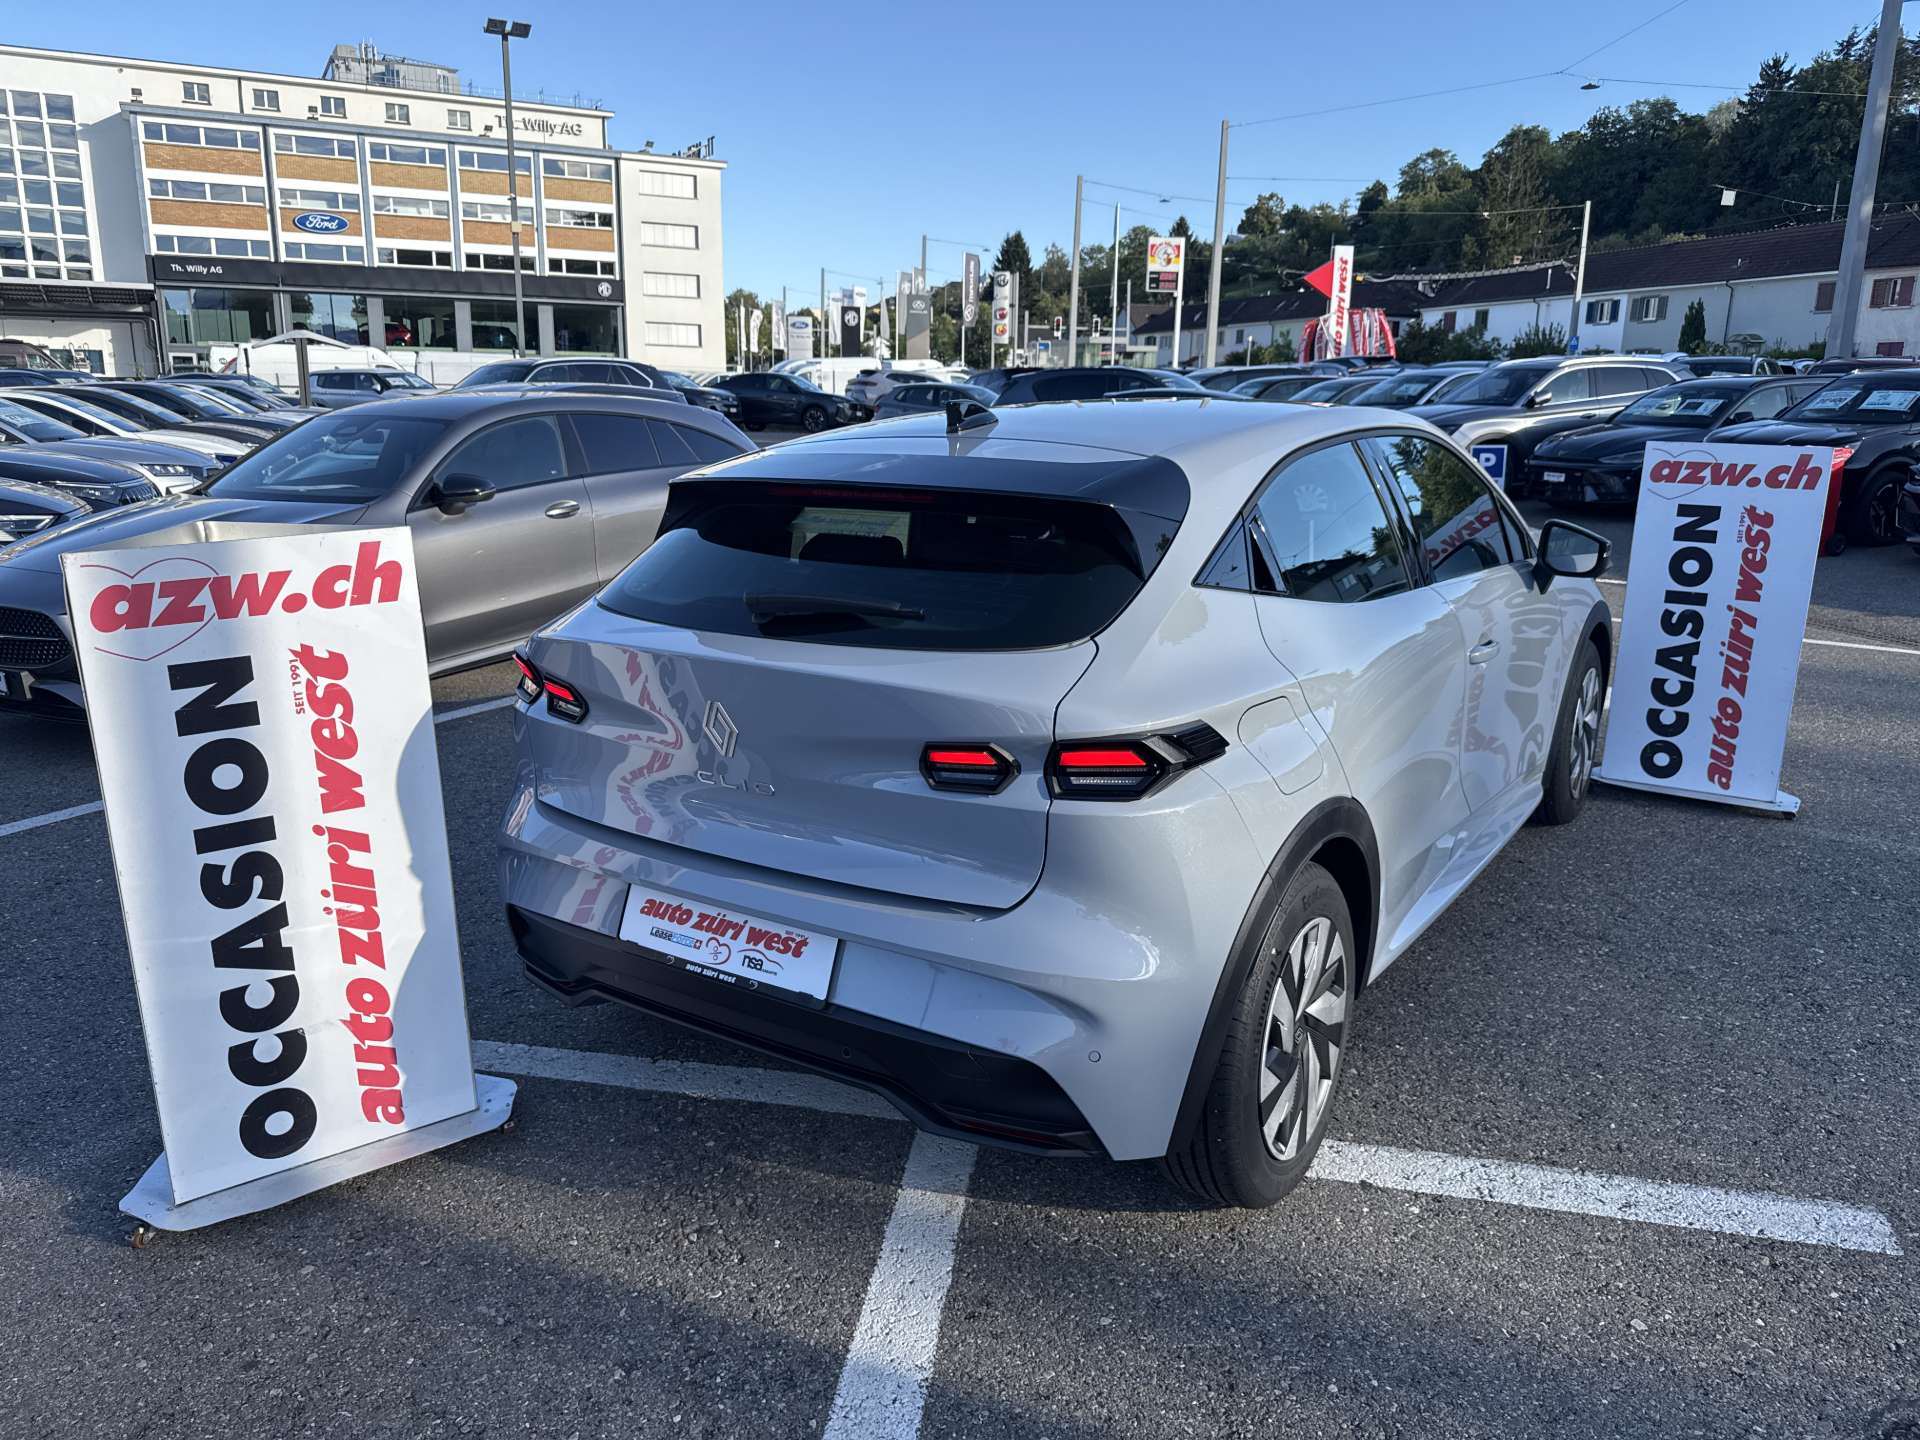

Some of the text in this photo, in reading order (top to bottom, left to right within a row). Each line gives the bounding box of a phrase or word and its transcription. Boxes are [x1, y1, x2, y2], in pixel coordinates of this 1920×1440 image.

[522, 117, 556, 136] Willy
[559, 121, 582, 136] AG
[306, 214, 338, 230] Ford
[171, 263, 223, 275] Th. Willy AG
[1338, 255, 1348, 294] west
[1479, 452, 1497, 468] P
[1649, 454, 1823, 490] azw.ch
[90, 541, 403, 633] azw.ch
[1640, 504, 1722, 779] OCCASION
[1707, 504, 1774, 790] auto züri west
[289, 659, 305, 715] SEIT 1991
[697, 770, 775, 797] CLIO
[288, 643, 406, 1126] auto züri west
[168, 656, 317, 1160] OCCASION
[640, 898, 809, 959] auto züri west
[685, 962, 702, 973] auto
[718, 973, 737, 984] west
[742, 954, 764, 971] nsa
